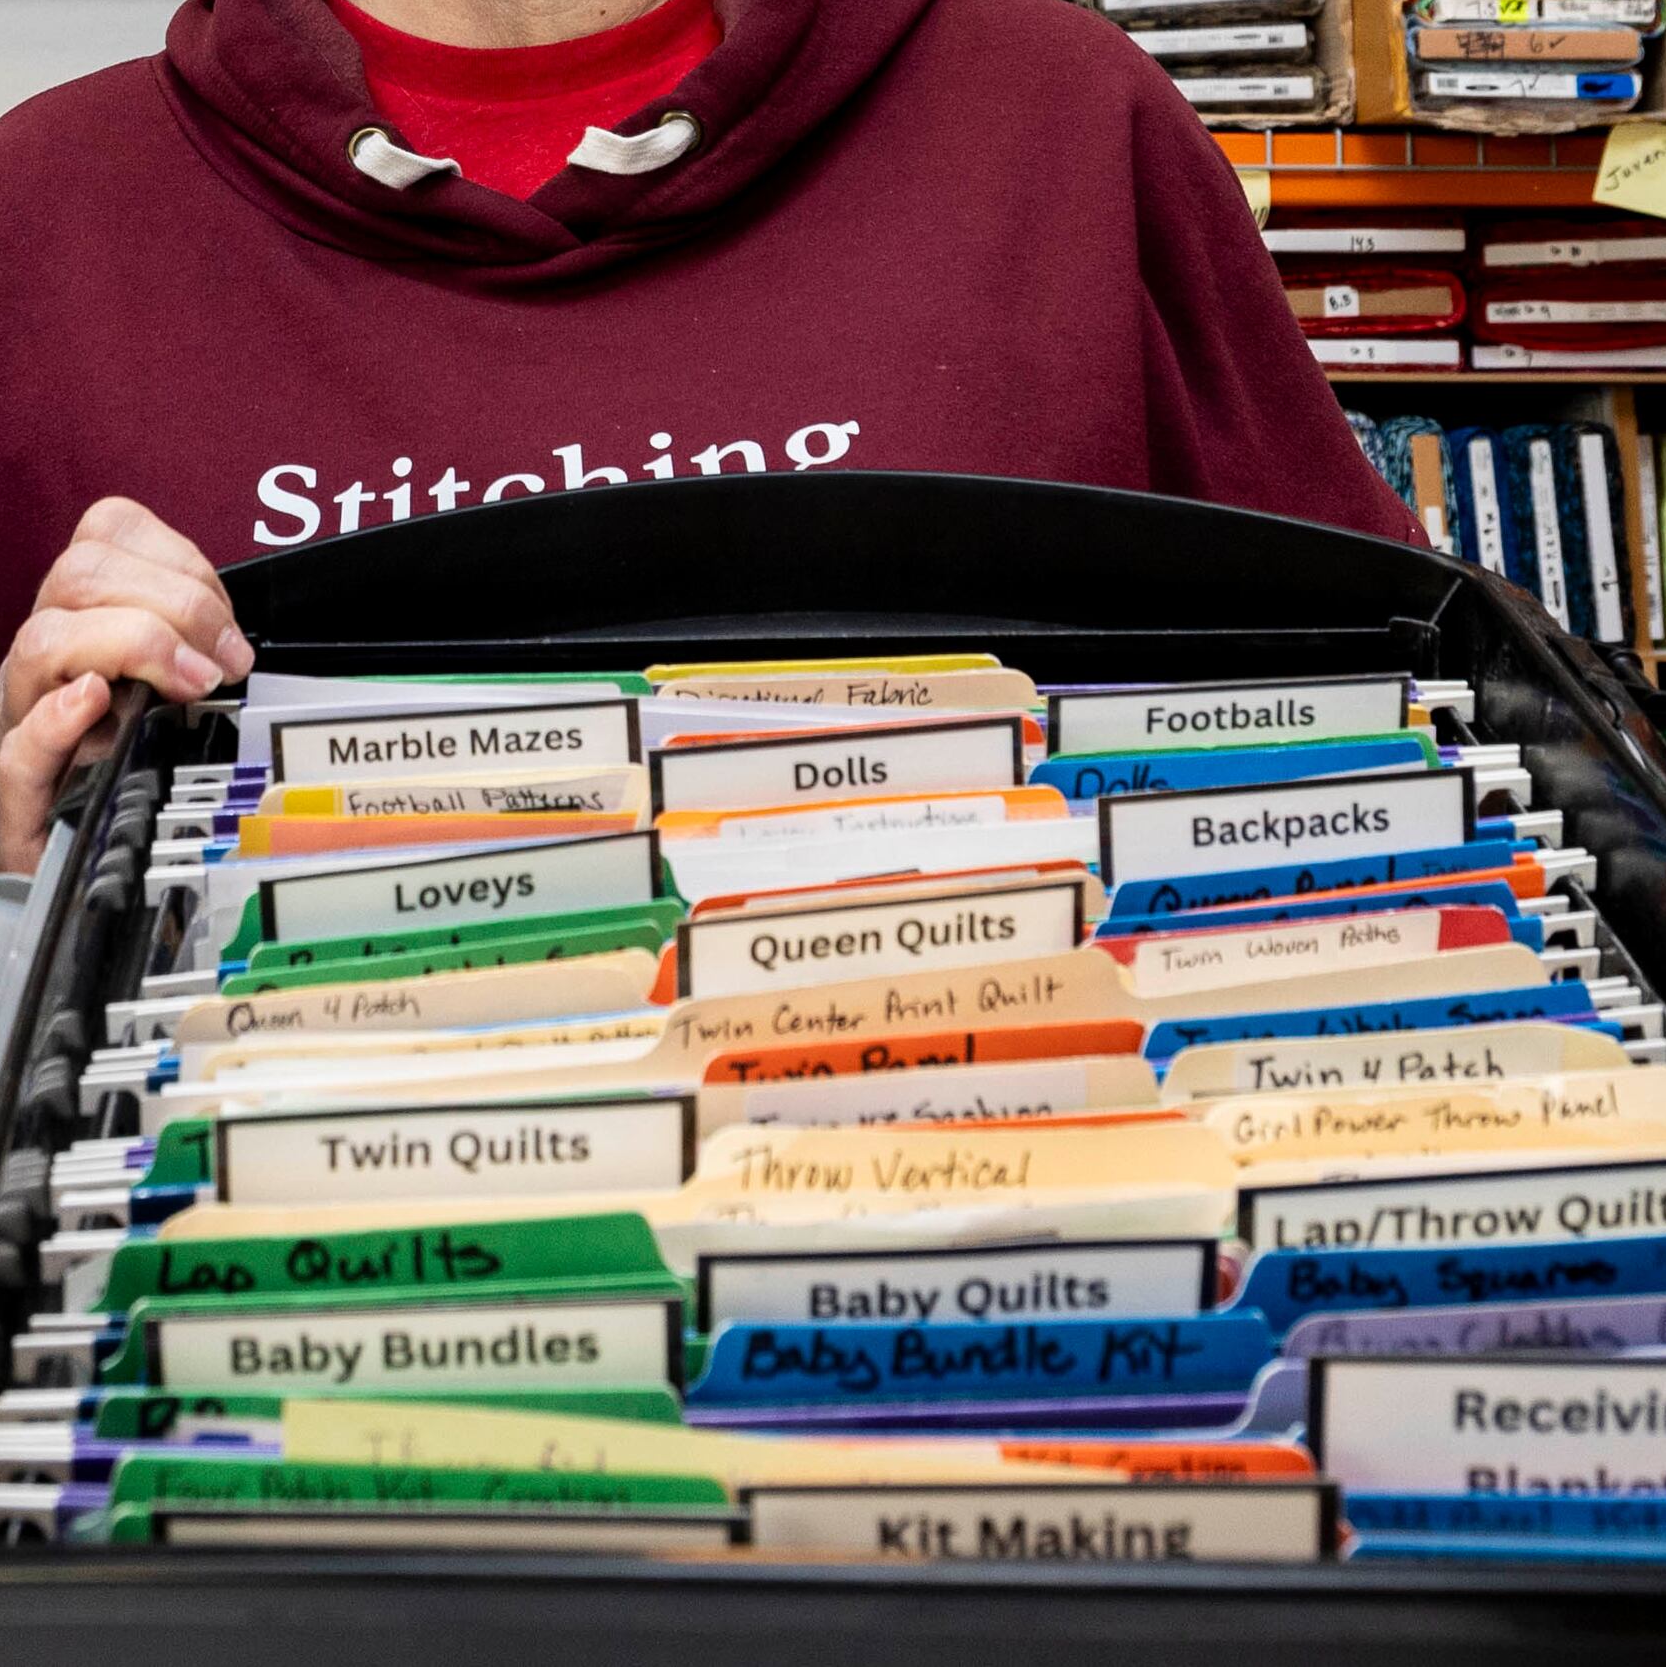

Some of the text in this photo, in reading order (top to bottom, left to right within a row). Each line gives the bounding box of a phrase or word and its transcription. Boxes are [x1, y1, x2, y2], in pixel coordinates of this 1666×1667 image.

[846, 682, 933, 705] Fabric
[1145, 701, 1316, 736] Footballs
[329, 725, 584, 766] Marble Mazes
[794, 756, 888, 791] Dolls
[347, 789, 465, 817] Football
[1192, 803, 1390, 850] Backpacks
[395, 871, 536, 914] Loveys
[749, 907, 1017, 971] Queen Quilts
[1162, 945, 1224, 972] Twin
[227, 991, 421, 1034] Queen 4 Patch
[676, 1014, 754, 1049] Twin
[771, 1002, 866, 1035] Center
[885, 989, 956, 1021] Print
[978, 974, 1064, 1014] Quilt
[1248, 1048, 1505, 1091] Twin 4 Patch
[1314, 1105, 1409, 1135] Power
[1432, 1104, 1523, 1131] Throw
[1541, 1083, 1620, 1124] Panel
[320, 1127, 592, 1173] Twin Quilts
[733, 1145, 1032, 1194] Throw Vertical
[1274, 1203, 1543, 1248] Lap/Throw
[286, 1232, 501, 1285] Quilts
[809, 1274, 1112, 1323] Baby Quilts
[1288, 1260, 1408, 1307] Baby
[231, 1327, 600, 1384] Baby Bundles
[742, 1330, 881, 1392] Baby
[890, 1326, 1076, 1379] Bundle
[877, 1513, 1193, 1563] Kit Making
